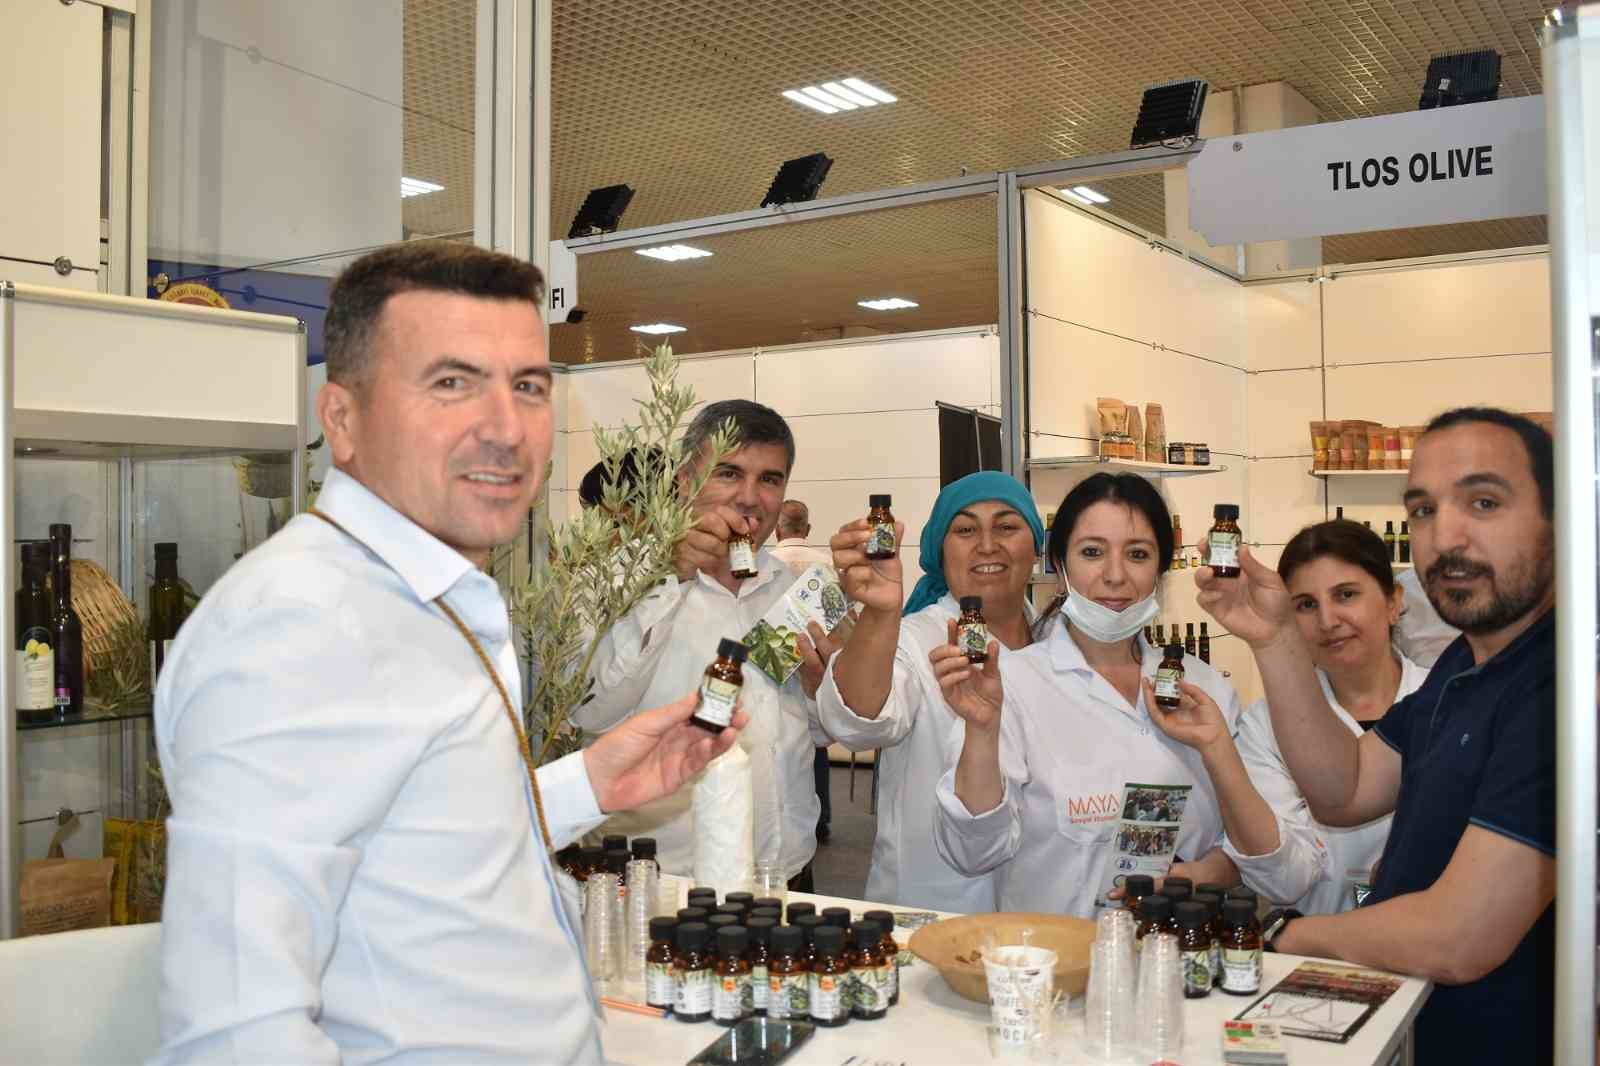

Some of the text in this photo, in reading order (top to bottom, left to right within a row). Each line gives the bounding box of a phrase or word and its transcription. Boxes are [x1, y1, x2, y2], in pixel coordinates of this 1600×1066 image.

[1327, 145, 1493, 191] TLOS OLIVE
[1068, 794, 1120, 816] MAYA
